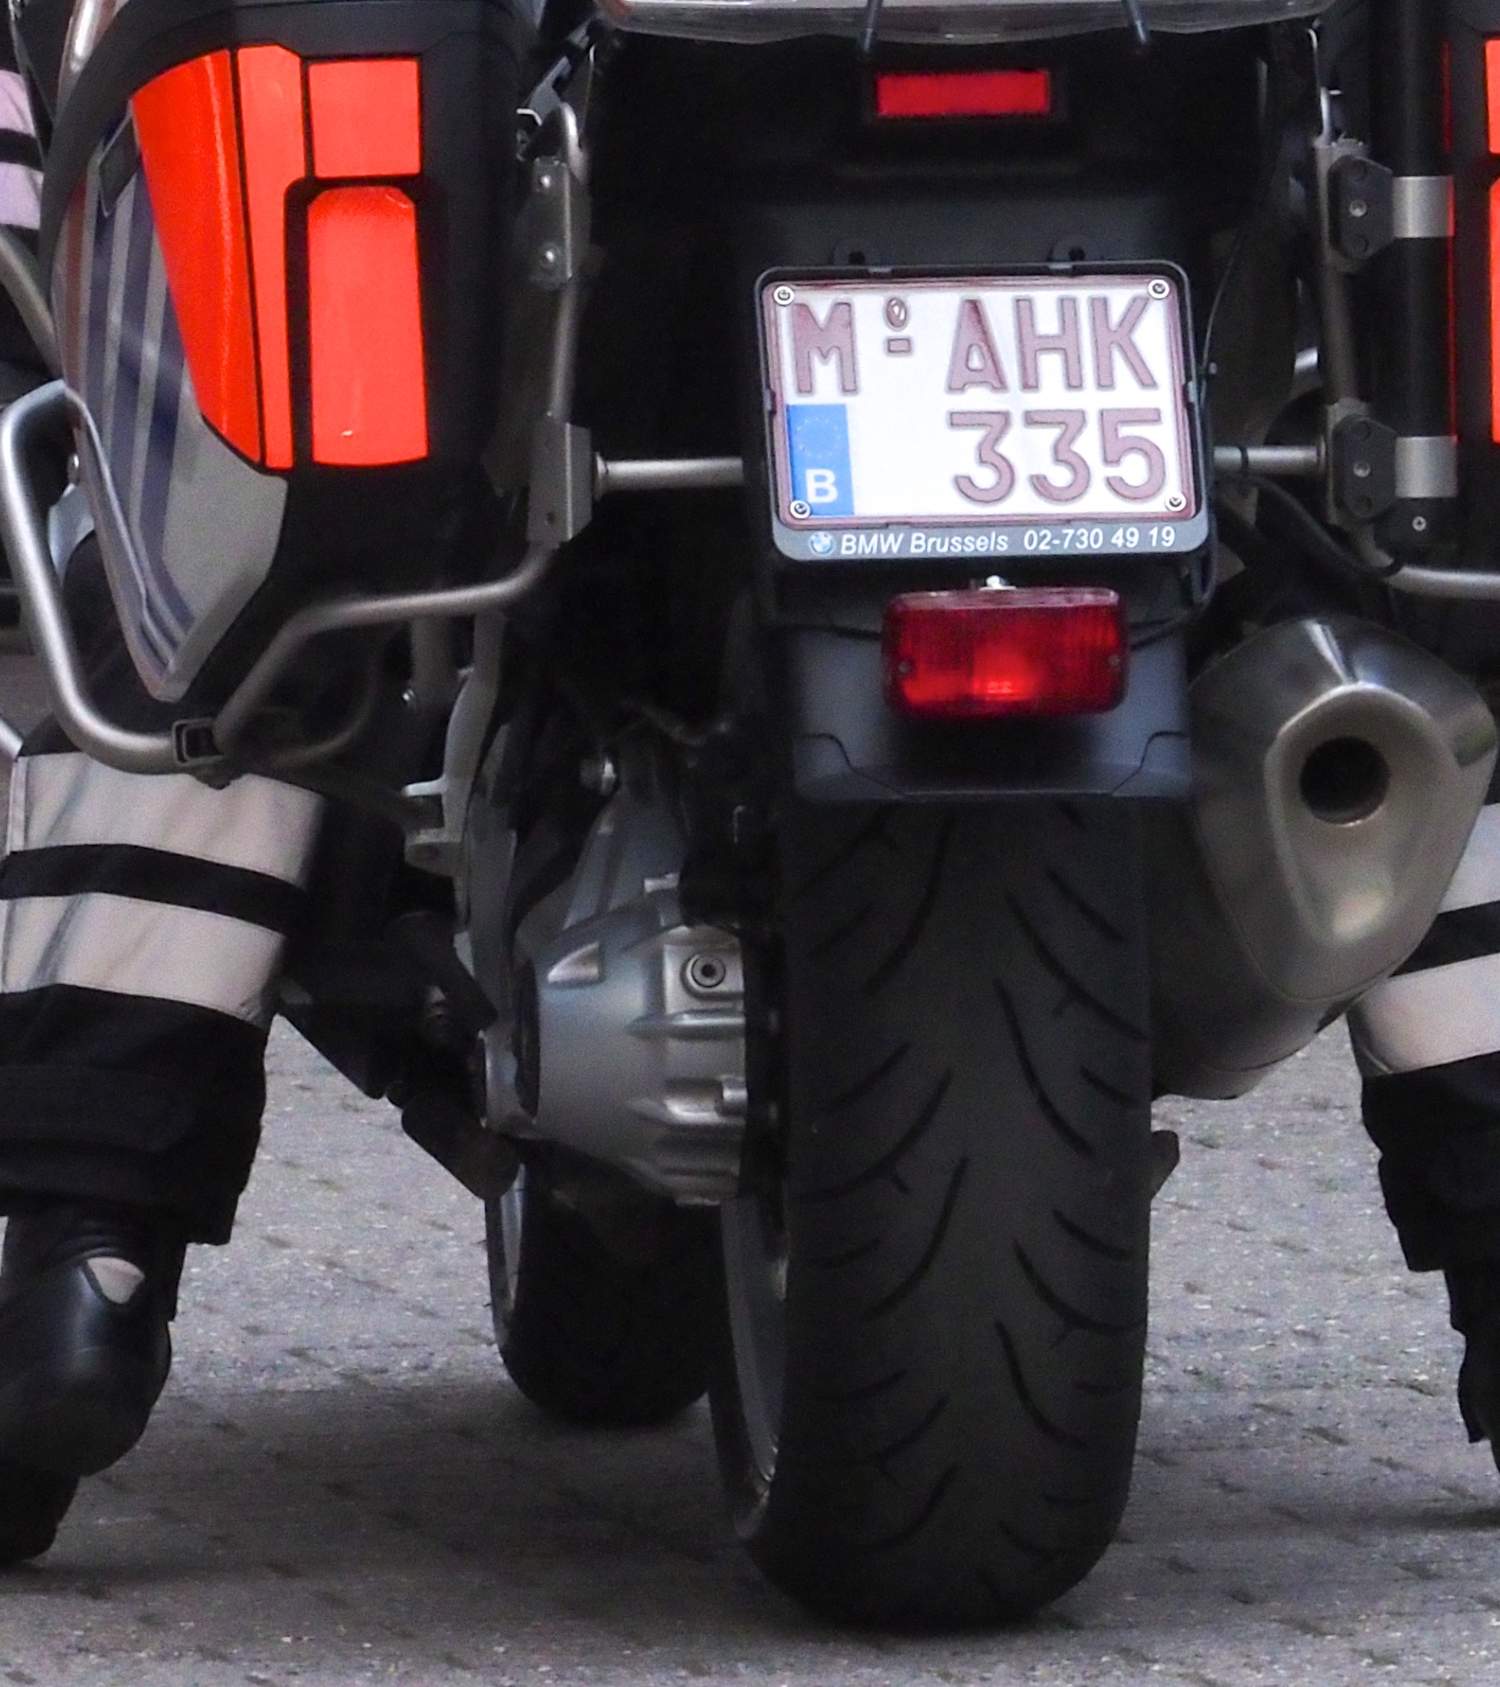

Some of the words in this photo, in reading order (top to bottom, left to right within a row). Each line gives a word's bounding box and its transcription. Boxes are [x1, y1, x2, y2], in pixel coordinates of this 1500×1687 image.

[948, 408, 1168, 504] 335
[805, 469, 838, 503] B
[841, 533, 902, 555] BMW
[909, 530, 1009, 554] Brussels
[1023, 528, 1104, 551] 02-730
[1111, 527, 1140, 549] 49
[1148, 525, 1176, 548] 19
